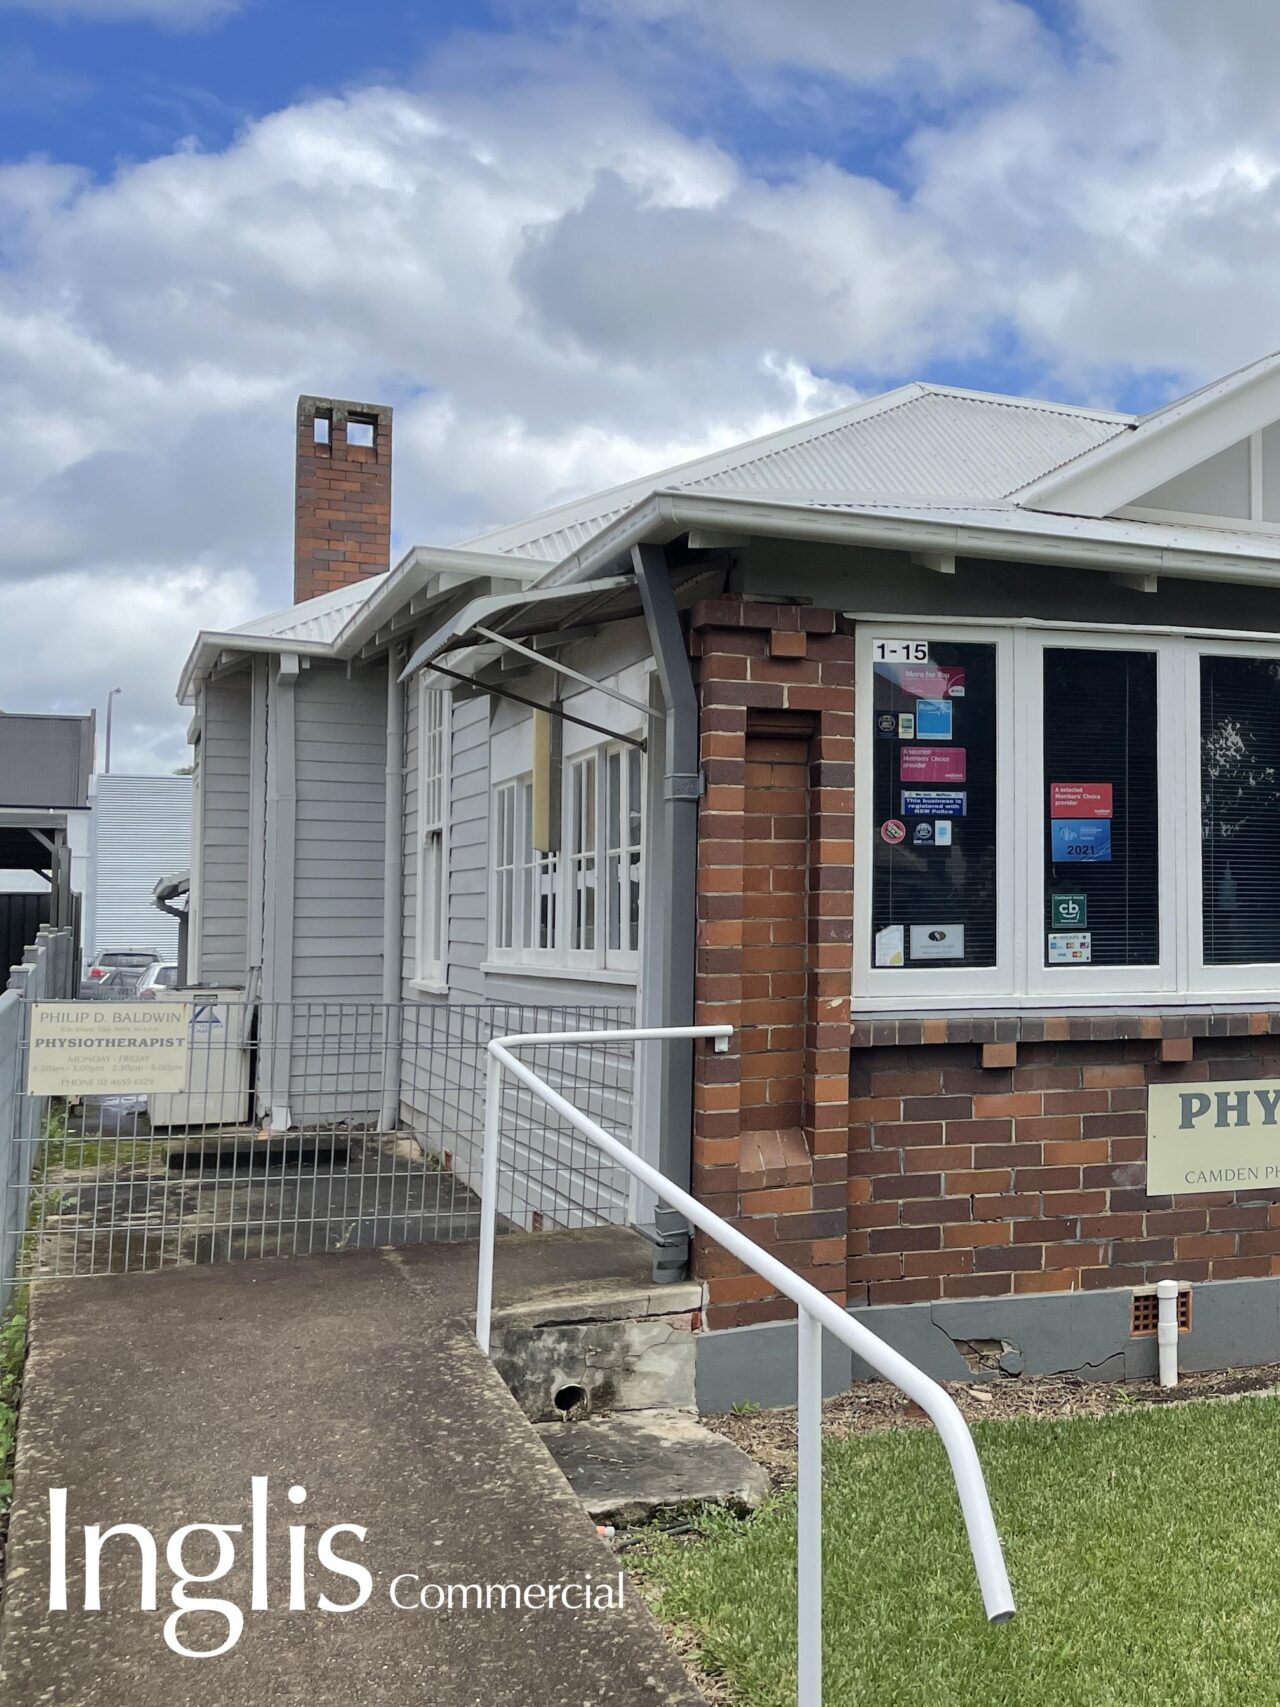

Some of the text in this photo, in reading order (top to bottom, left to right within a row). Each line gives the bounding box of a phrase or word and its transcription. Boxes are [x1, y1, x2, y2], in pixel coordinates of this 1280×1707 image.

[1067, 845, 1096, 856] 2021
[40, 1012, 90, 1024] PHILIP
[112, 1011, 182, 1024] BALDWIN
[34, 1037, 186, 1048] PHYSIOTHERAPIST
[67, 1055, 110, 1063] MONDAY
[118, 1055, 150, 1063] FRIDAY
[1184, 1166, 1259, 1184] CAMDEN
